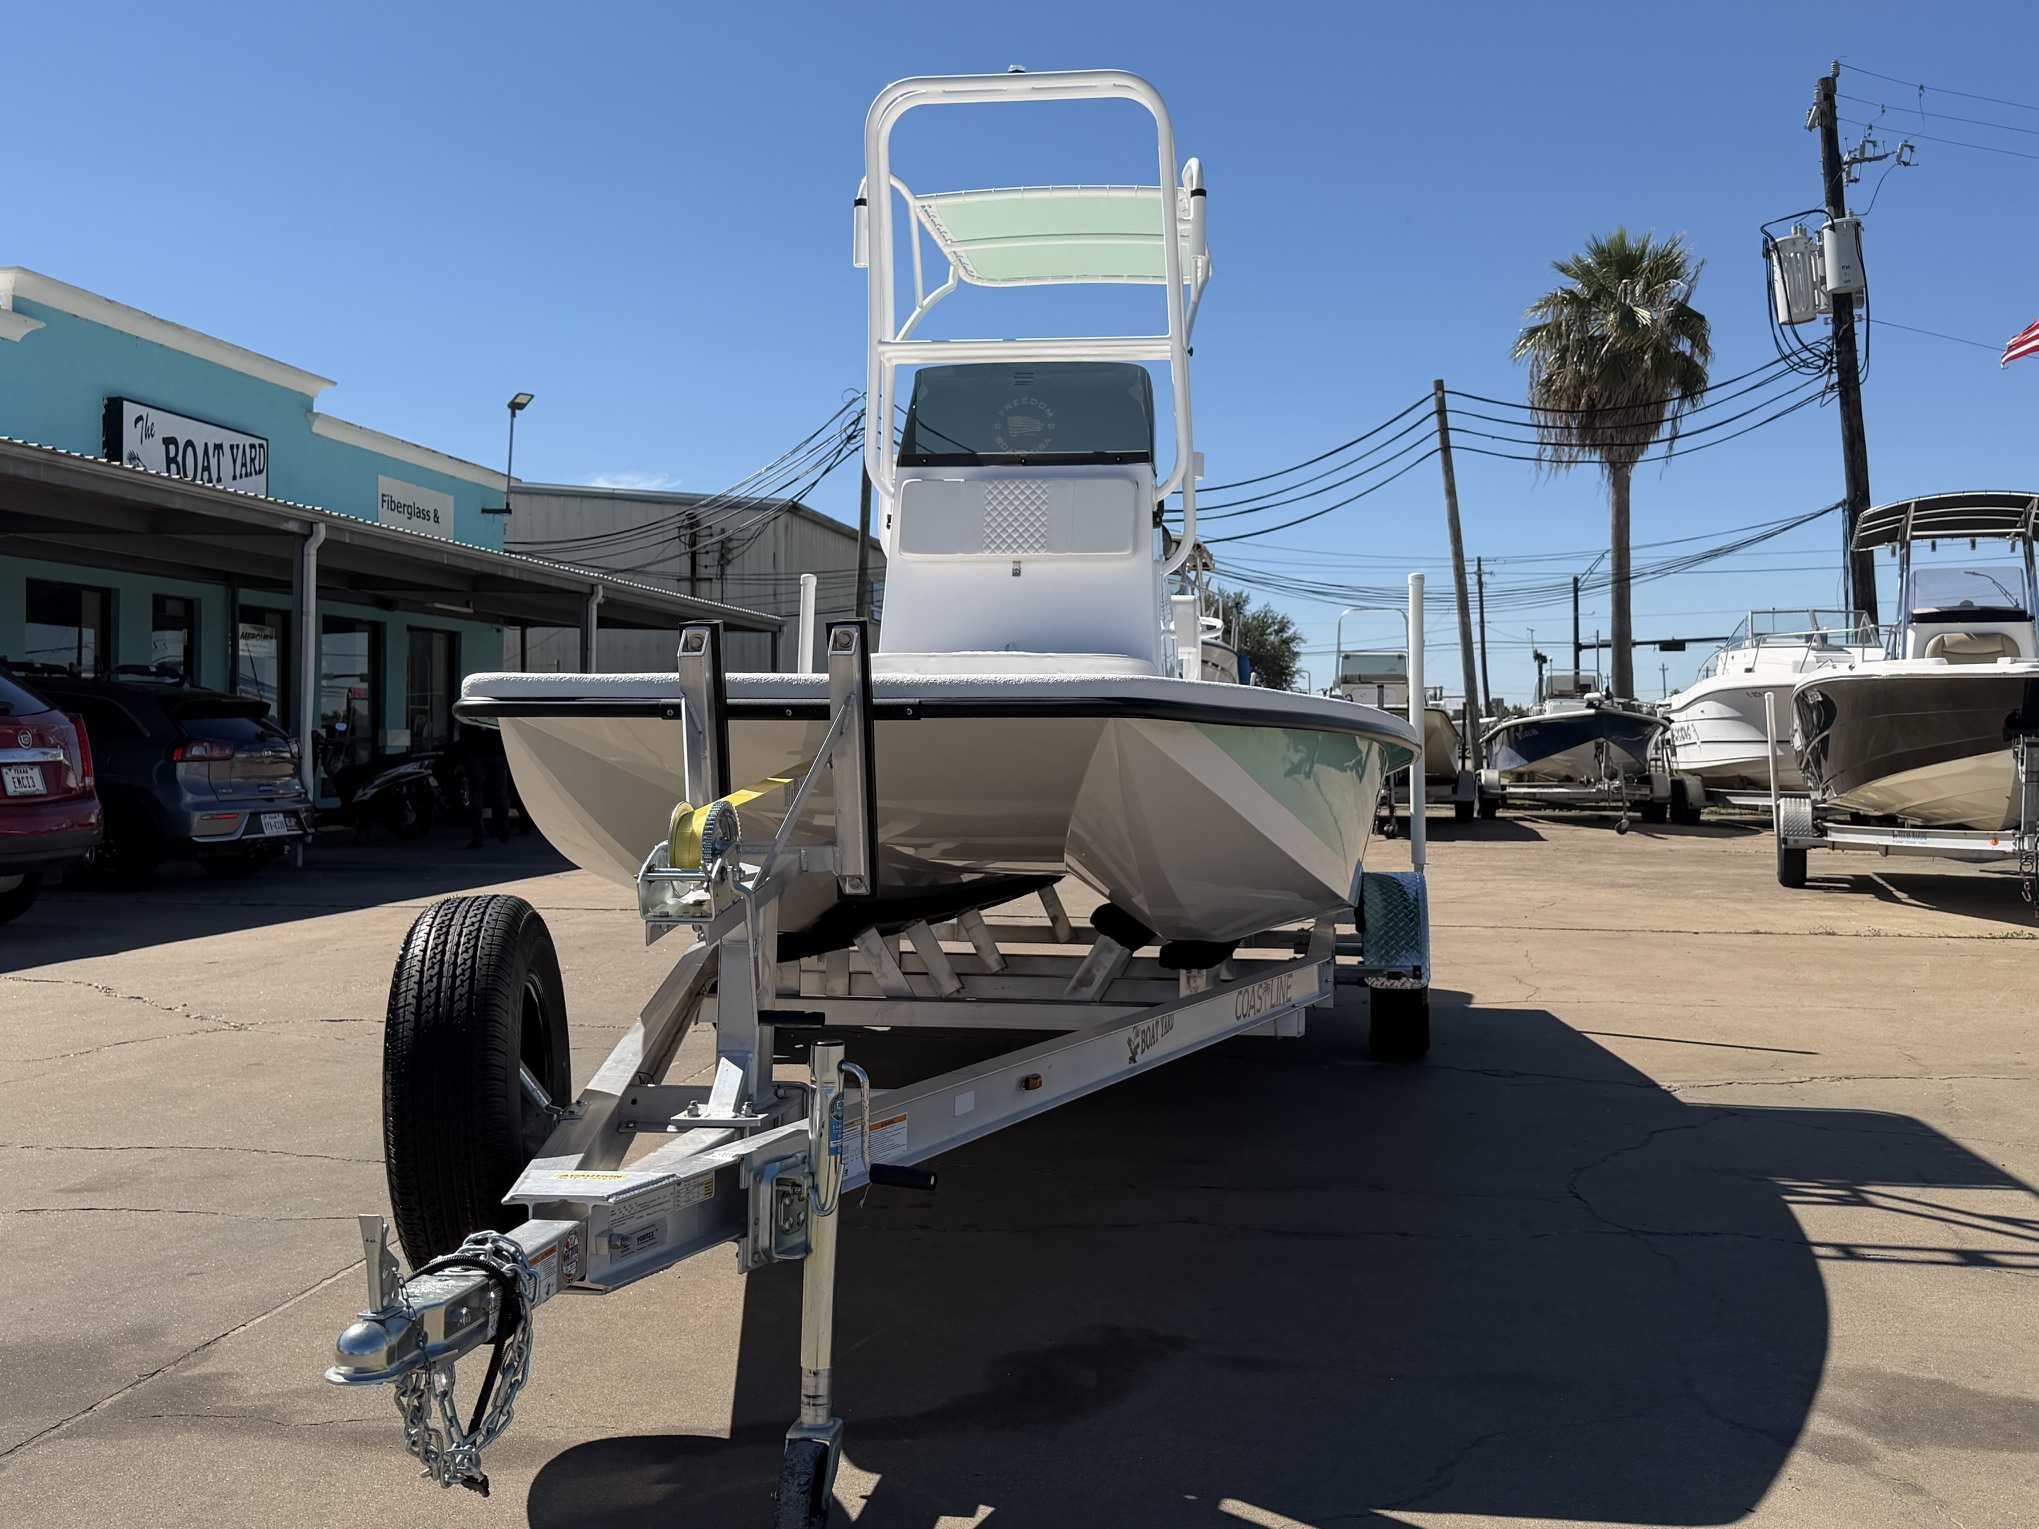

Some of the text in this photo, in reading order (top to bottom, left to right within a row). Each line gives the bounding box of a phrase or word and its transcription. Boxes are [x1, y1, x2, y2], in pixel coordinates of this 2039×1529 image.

[134, 411, 155, 445] The
[162, 436, 266, 484] BOAT YARD
[381, 493, 440, 524] Fiberglass &
